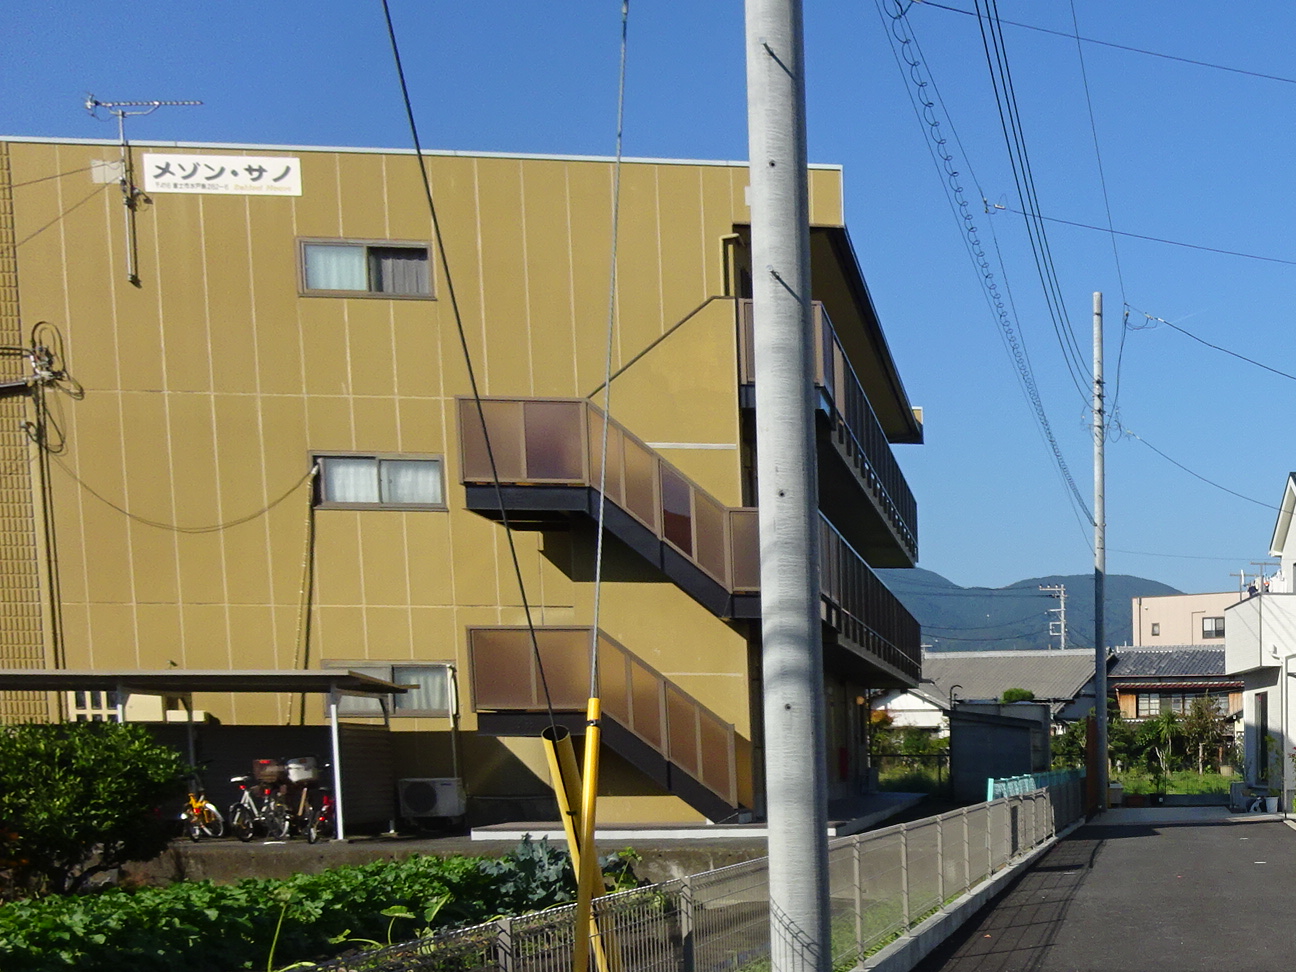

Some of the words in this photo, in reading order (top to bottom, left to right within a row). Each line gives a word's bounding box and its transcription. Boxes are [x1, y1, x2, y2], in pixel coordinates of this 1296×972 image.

[153, 161, 291, 183] メゾン・サノ
